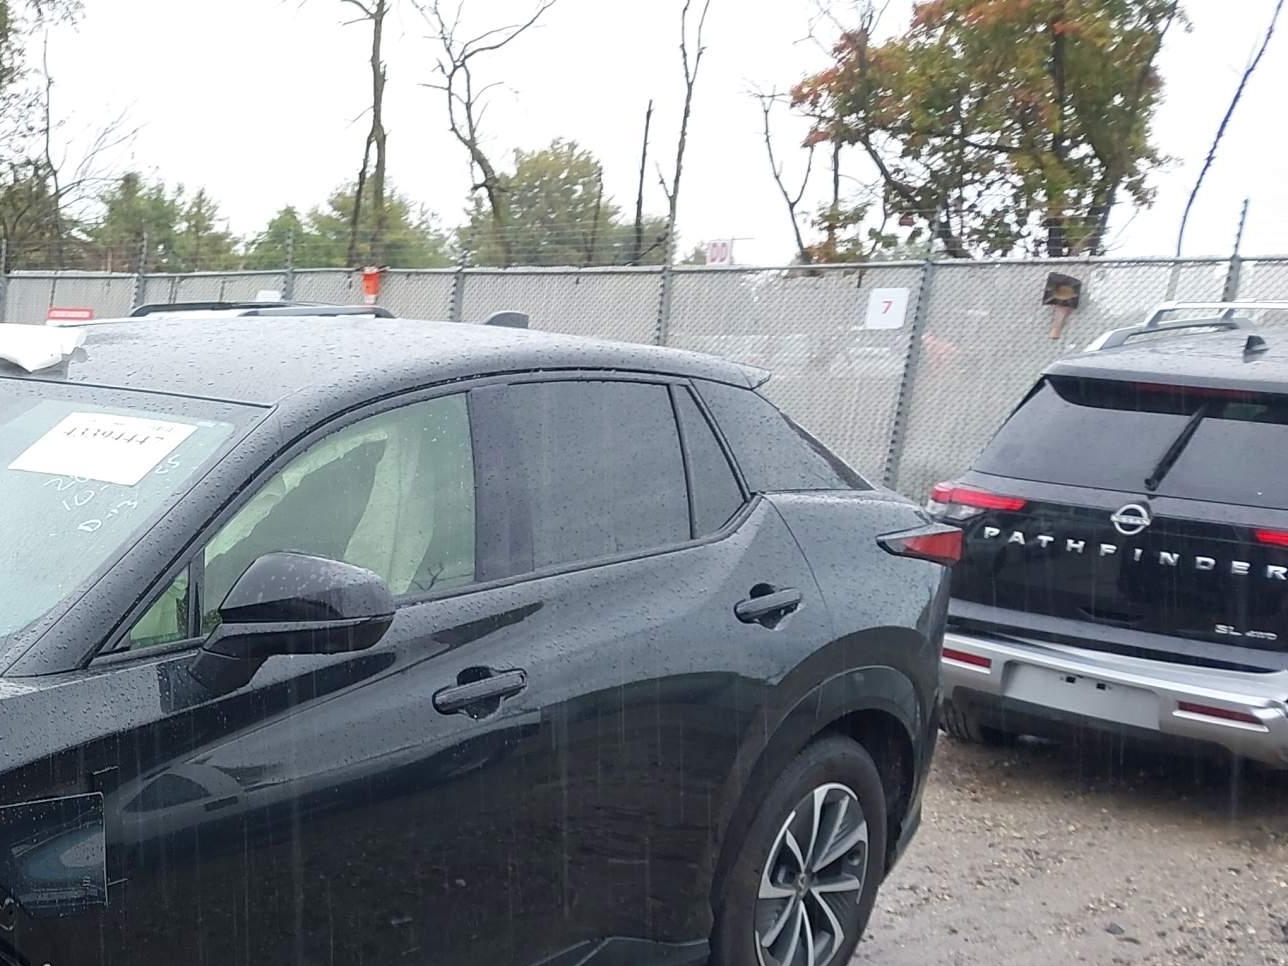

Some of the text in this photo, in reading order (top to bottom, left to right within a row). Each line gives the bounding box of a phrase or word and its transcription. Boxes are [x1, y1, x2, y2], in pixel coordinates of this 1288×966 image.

[882, 300, 893, 314] 7
[983, 526, 1288, 580] PATHFINDER
[1215, 624, 1242, 636] SL
